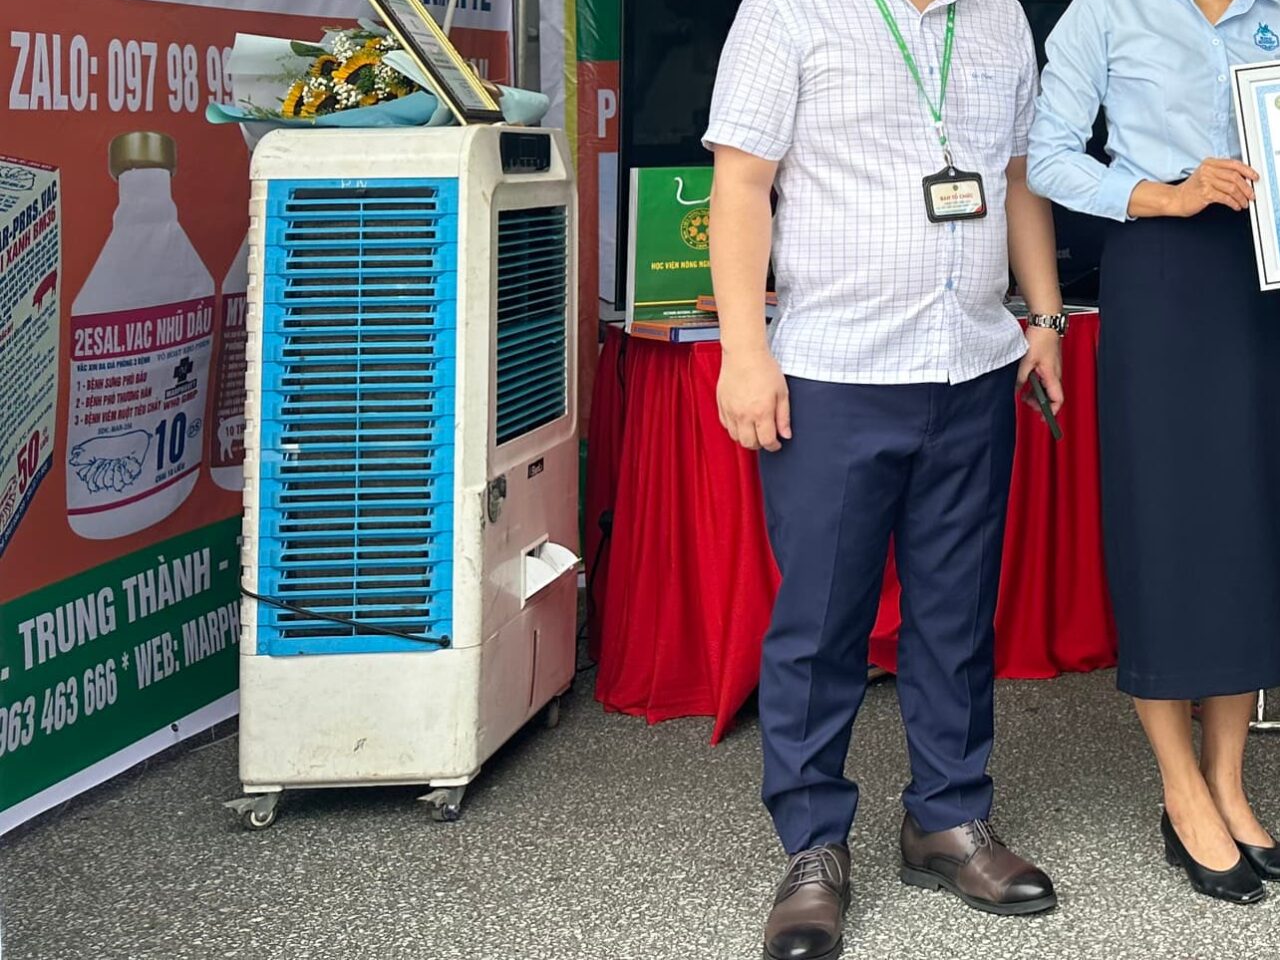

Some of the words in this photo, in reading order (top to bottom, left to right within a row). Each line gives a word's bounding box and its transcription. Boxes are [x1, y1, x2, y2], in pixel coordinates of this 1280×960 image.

[8, 30, 98, 112] ZALO:
[107, 38, 158, 113] 097
[167, 42, 200, 113] 98
[74, 319, 153, 357] 2ESAL.VAC
[16, 429, 41, 495] 50
[155, 412, 187, 471] 10
[18, 586, 117, 671] TRUNG
[122, 547, 211, 624] THÀNH
[40, 676, 78, 735] 463
[83, 658, 118, 717] 666
[134, 631, 180, 690] WEB:
